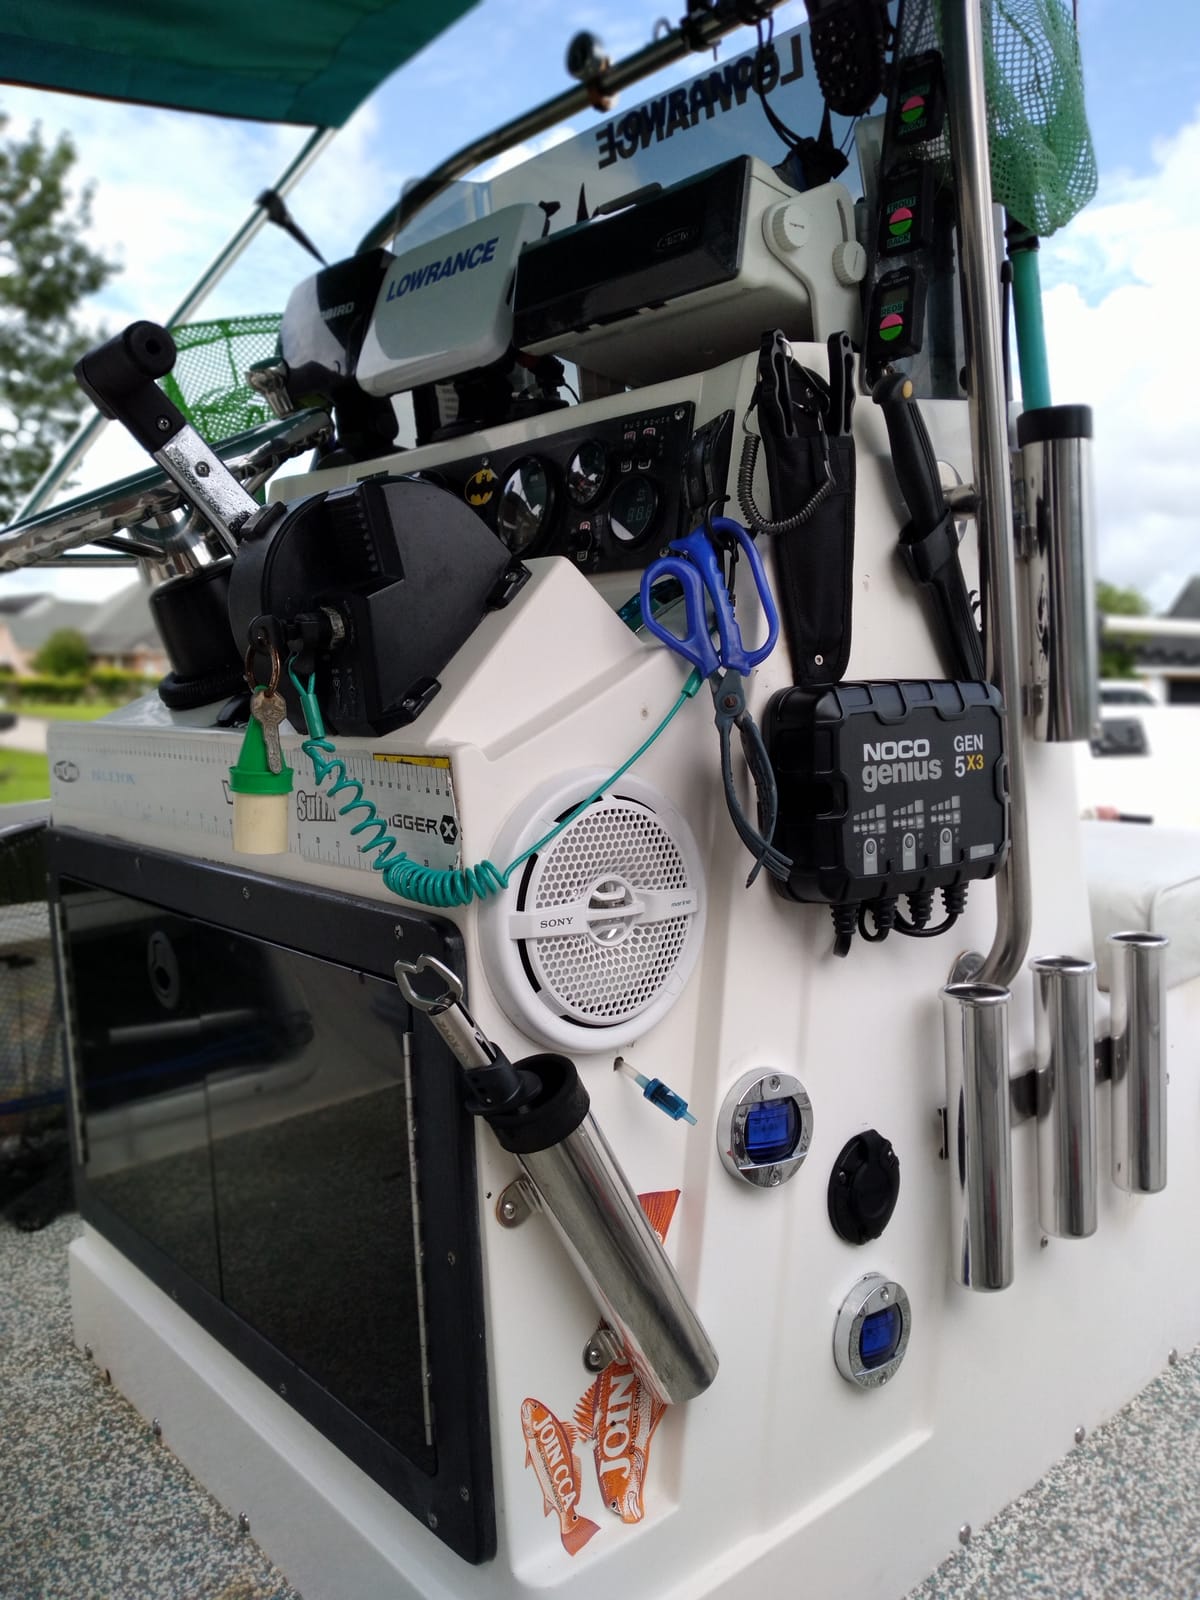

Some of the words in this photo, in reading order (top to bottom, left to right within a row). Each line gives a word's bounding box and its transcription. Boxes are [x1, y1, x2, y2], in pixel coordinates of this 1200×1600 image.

[386, 237, 499, 302] LOWRANCE
[863, 739, 930, 762] NOCO
[954, 734, 983, 752] GEN
[862, 759, 942, 792] genius
[540, 917, 574, 929] SONY
[599, 1372, 635, 1479] JOIN
[533, 1415, 564, 1466] JOIN
[553, 1464, 577, 1512] CCA
